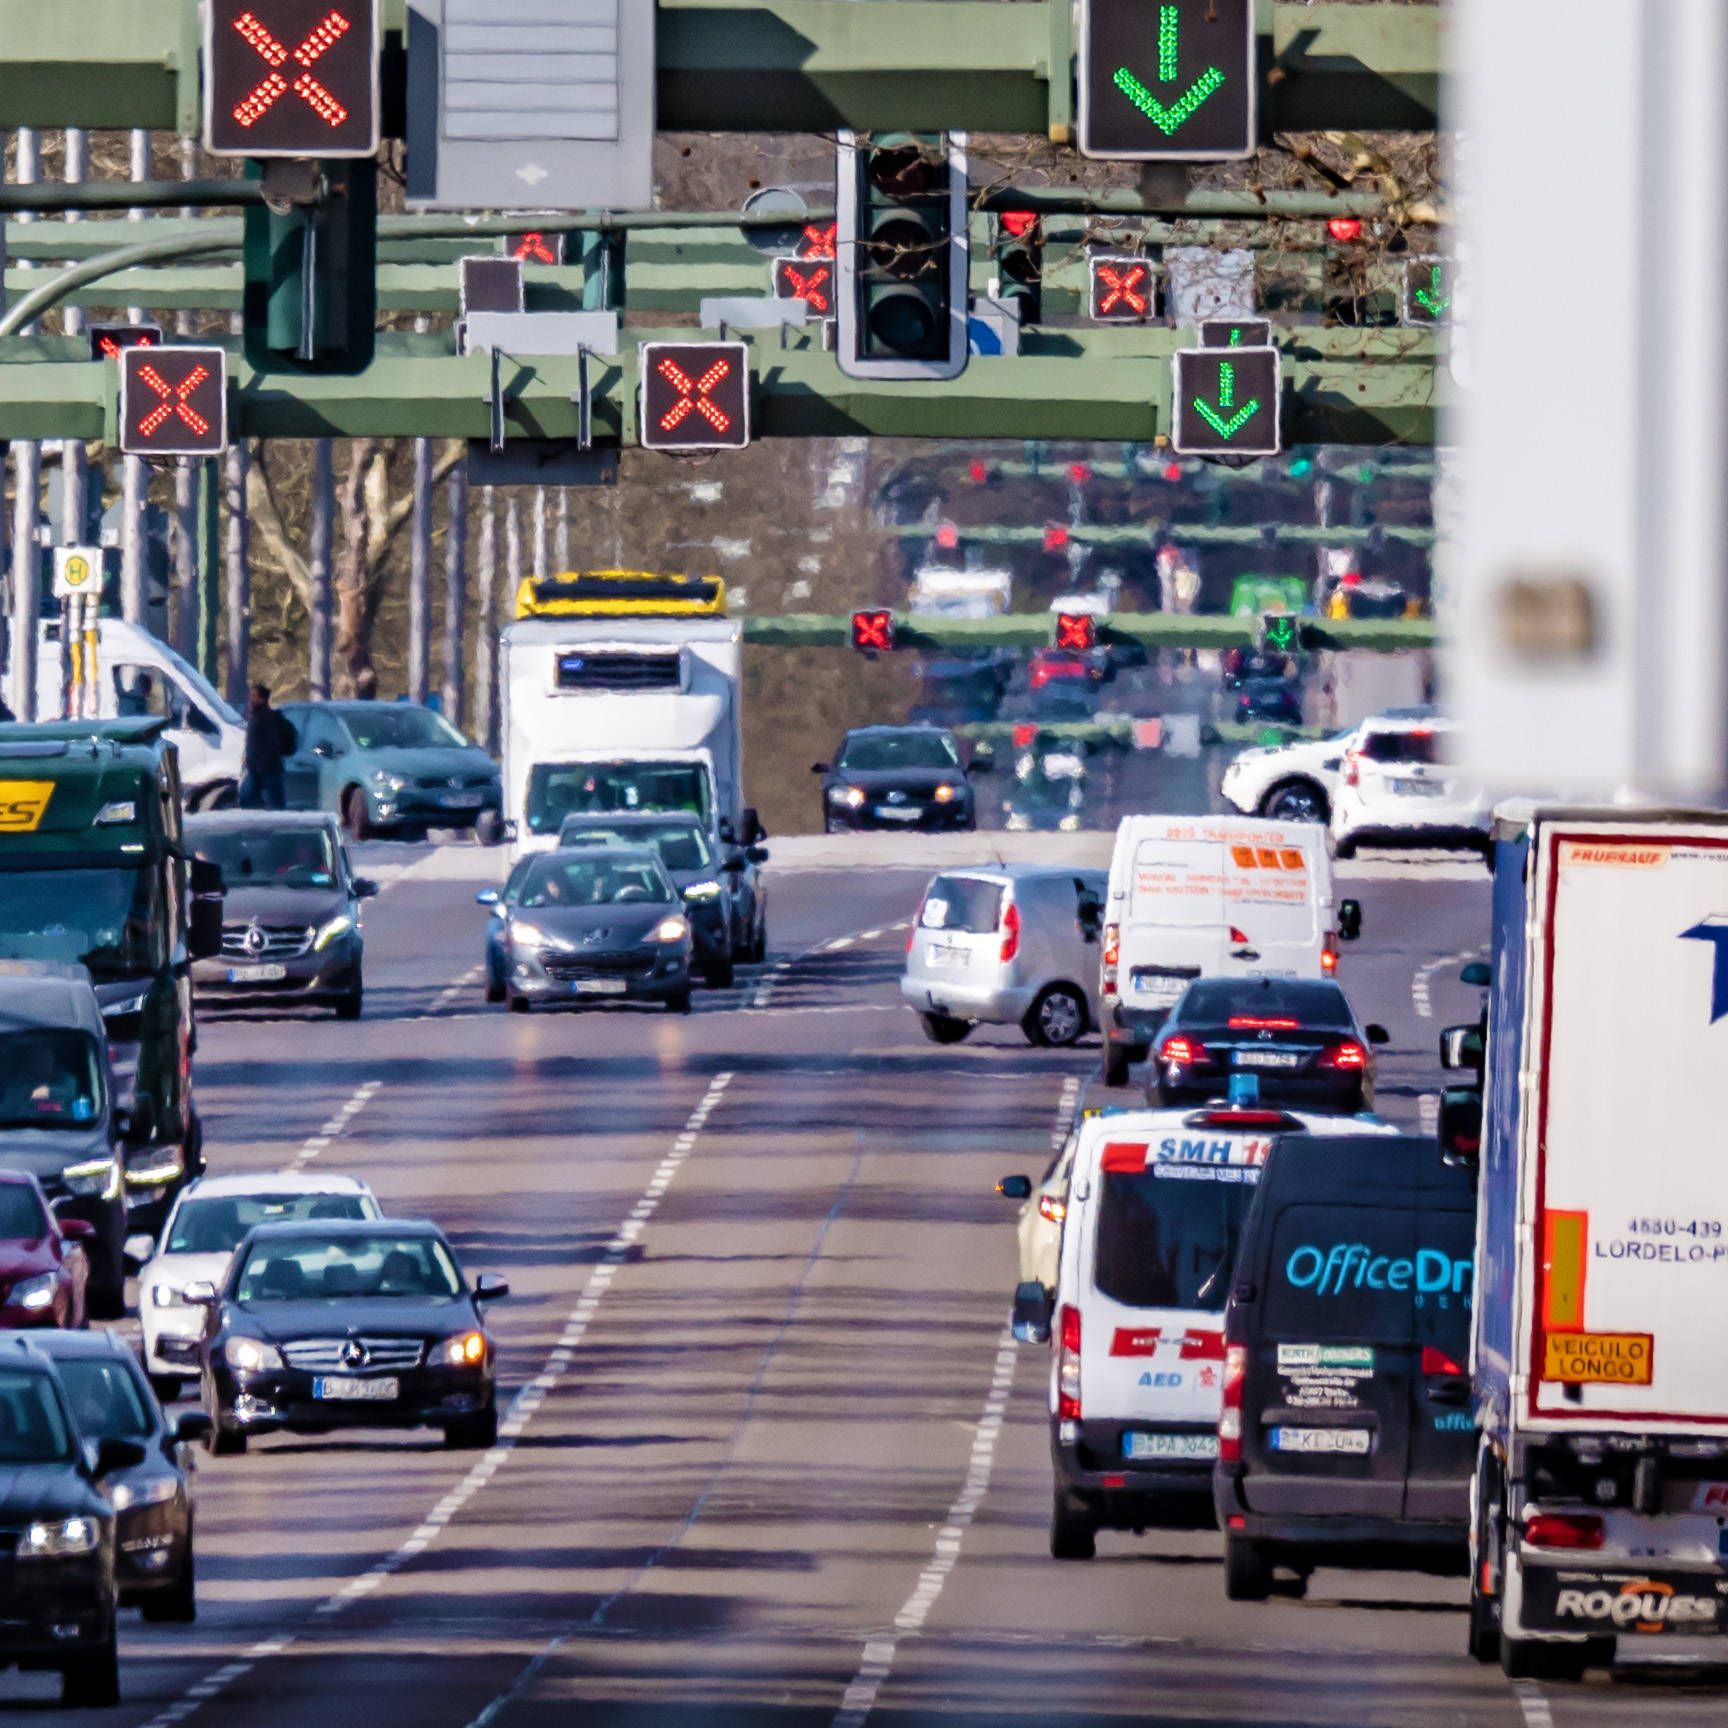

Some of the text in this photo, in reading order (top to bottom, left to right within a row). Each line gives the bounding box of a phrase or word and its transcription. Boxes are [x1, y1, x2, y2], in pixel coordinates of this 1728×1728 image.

[1157, 1138, 1232, 1164] SMH
[1286, 1243, 1474, 1296] OfficeDr
[1138, 1371, 1183, 1388] AED
[1559, 1357, 1635, 1378] LONGO
[1556, 1588, 1717, 1627] ROQUES
